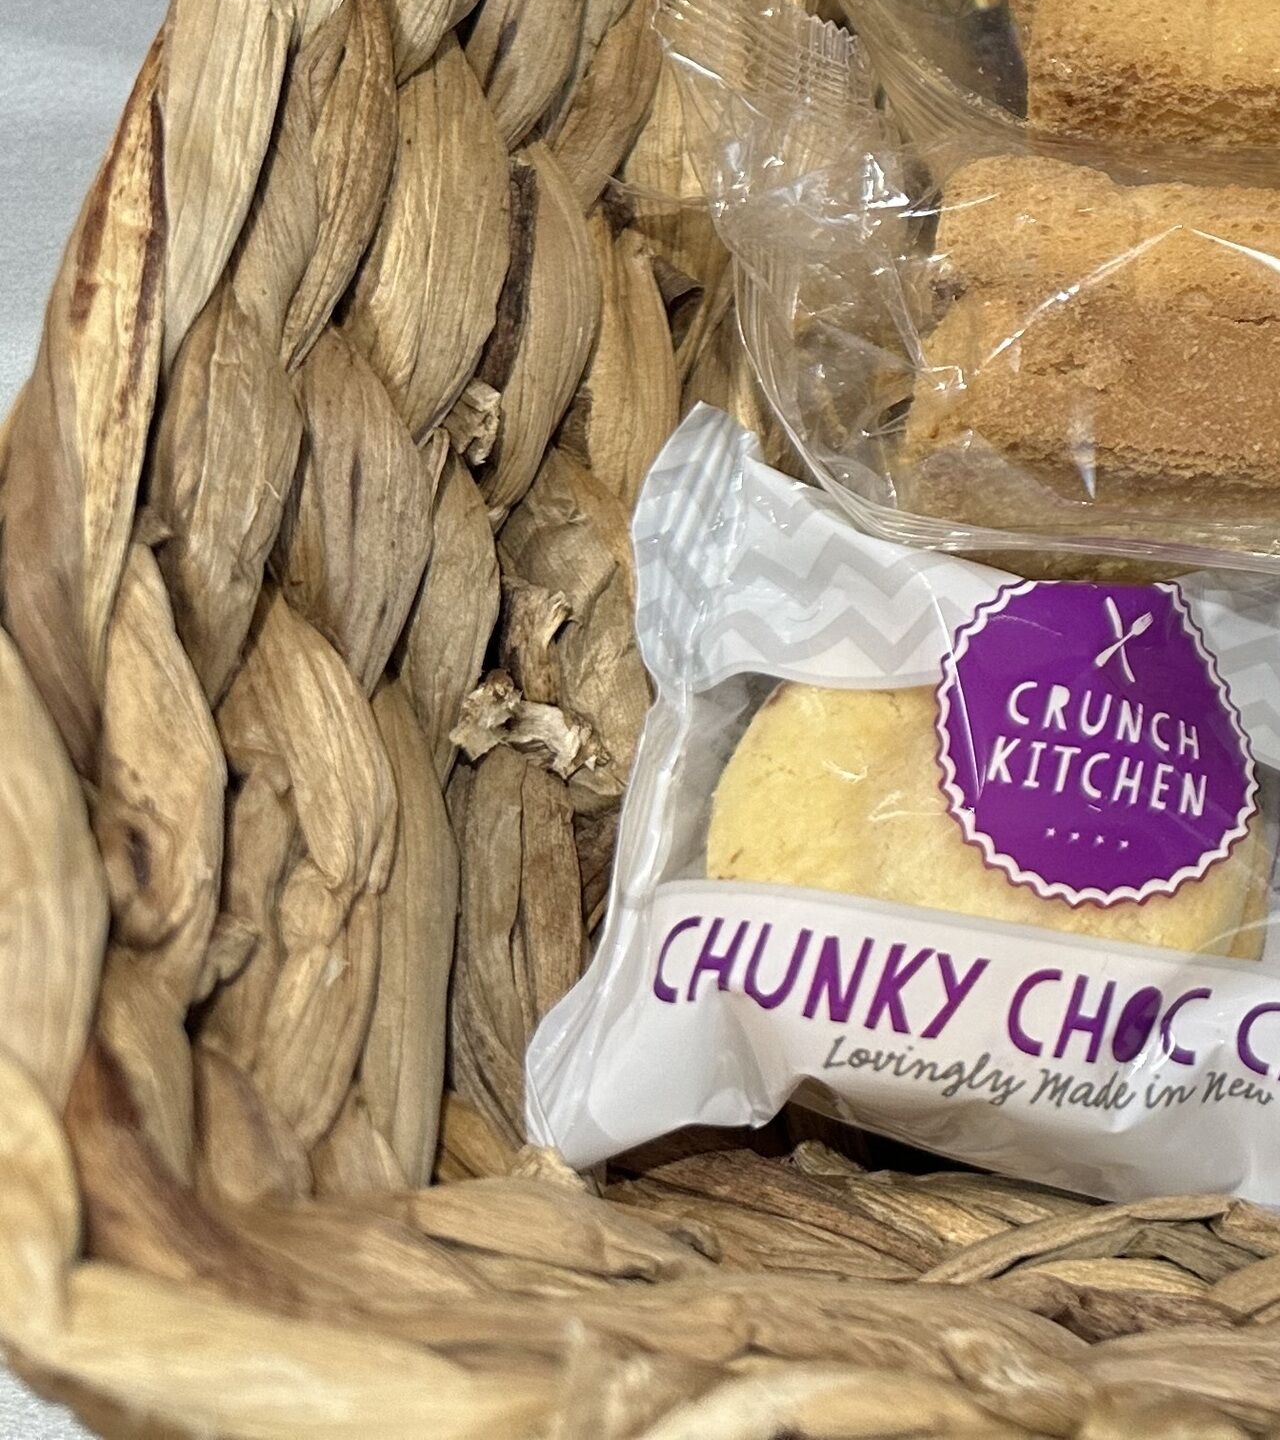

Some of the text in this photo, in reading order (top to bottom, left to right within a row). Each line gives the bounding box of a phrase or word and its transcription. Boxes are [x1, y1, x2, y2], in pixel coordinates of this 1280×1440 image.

[1008, 680, 1200, 760] CRUNCH
[986, 735, 1208, 817] KITCHEN
[653, 916, 990, 1040] CHUNKY
[1004, 968, 1212, 1066] CHOC
[823, 1034, 1023, 1107] Lovingly
[1029, 1069, 1137, 1112] Made
[1145, 1074, 1196, 1109] in
[1201, 1070, 1274, 1107] New
